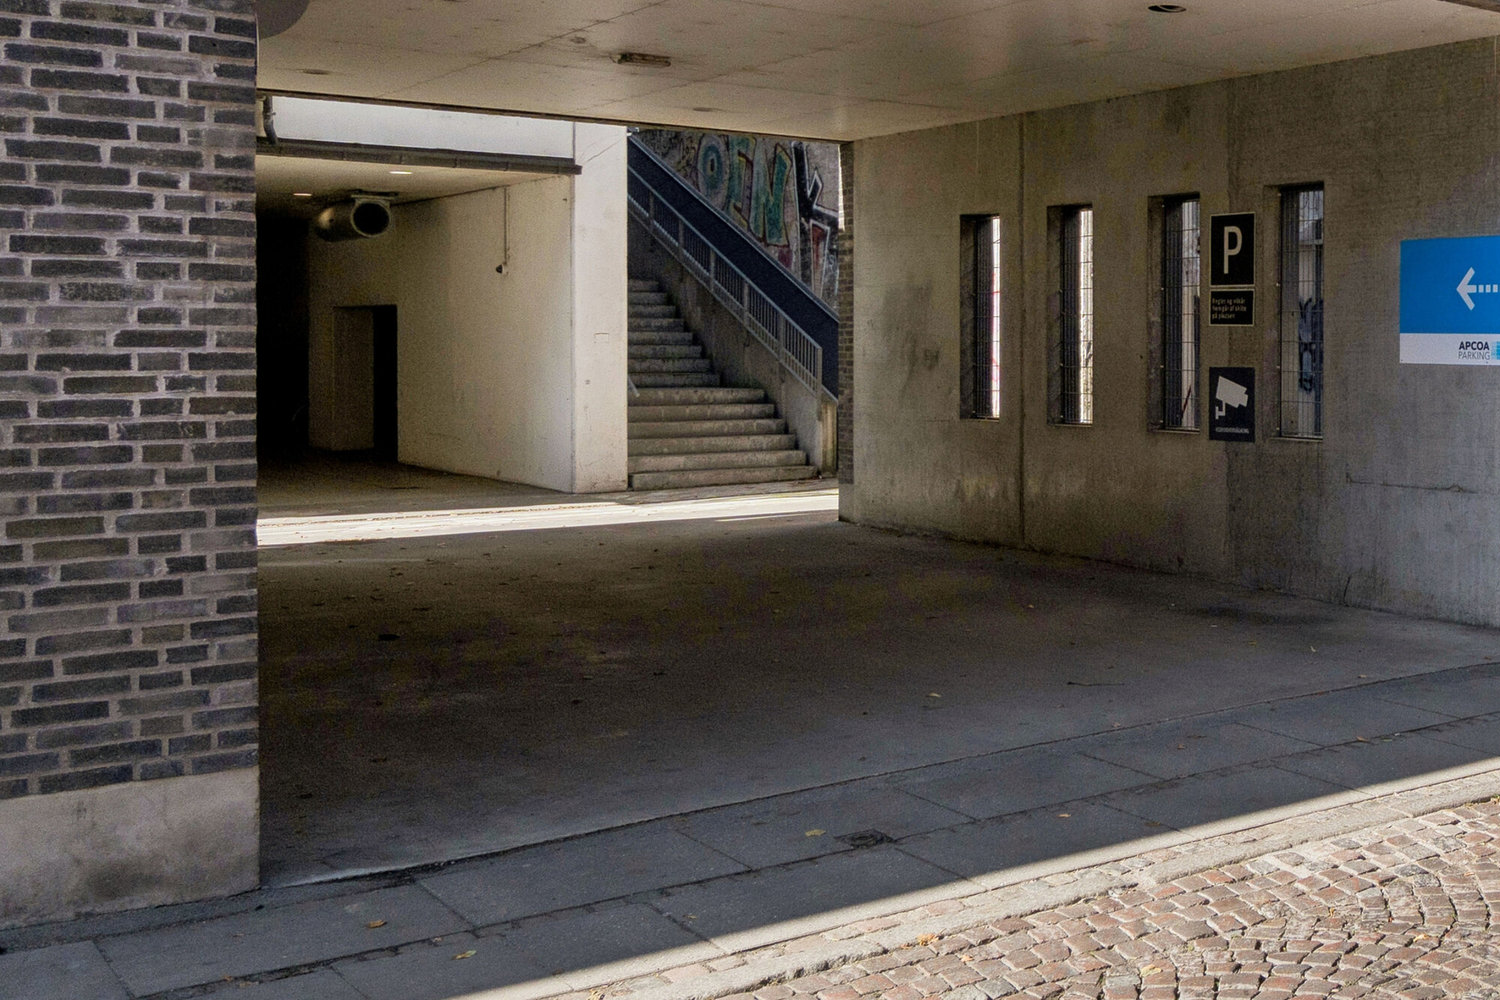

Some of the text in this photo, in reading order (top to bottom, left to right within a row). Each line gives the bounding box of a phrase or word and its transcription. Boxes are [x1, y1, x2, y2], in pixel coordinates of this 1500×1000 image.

[1223, 225, 1242, 274] P
[1458, 341, 1490, 351] APCOA
[1458, 351, 1491, 360] PARKING
